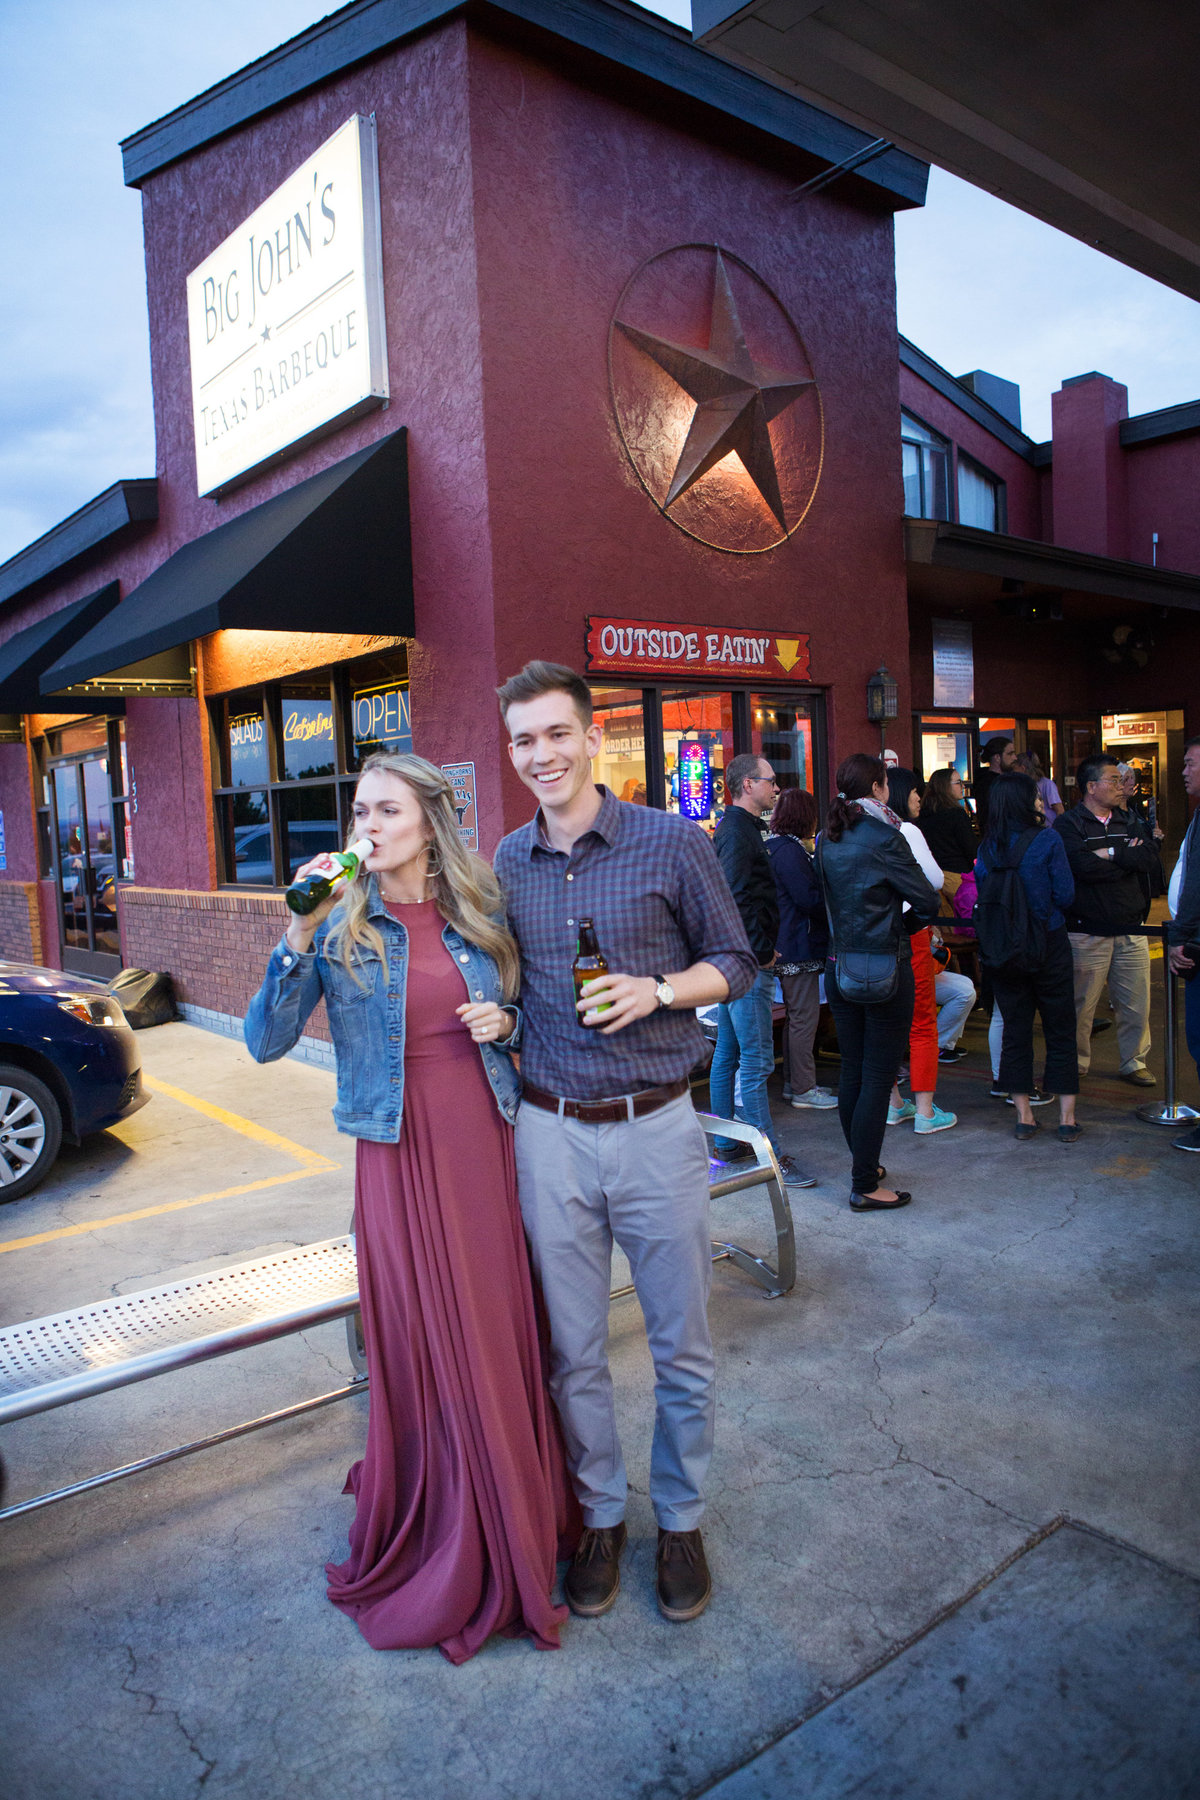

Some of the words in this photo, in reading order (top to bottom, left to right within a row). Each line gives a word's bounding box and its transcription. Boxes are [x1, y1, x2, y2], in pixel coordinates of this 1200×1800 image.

[200, 386, 249, 446] TEXAS
[253, 309, 358, 411] BARBEQUE
[600, 624, 700, 661] OUTSIDE
[705, 634, 770, 664] EATIN'
[229, 715, 263, 746] SALADS
[357, 689, 411, 736] OPEN
[605, 738, 631, 753] ORDER
[444, 767, 472, 777] ONGHORNS
[688, 744, 703, 816] OPEN
